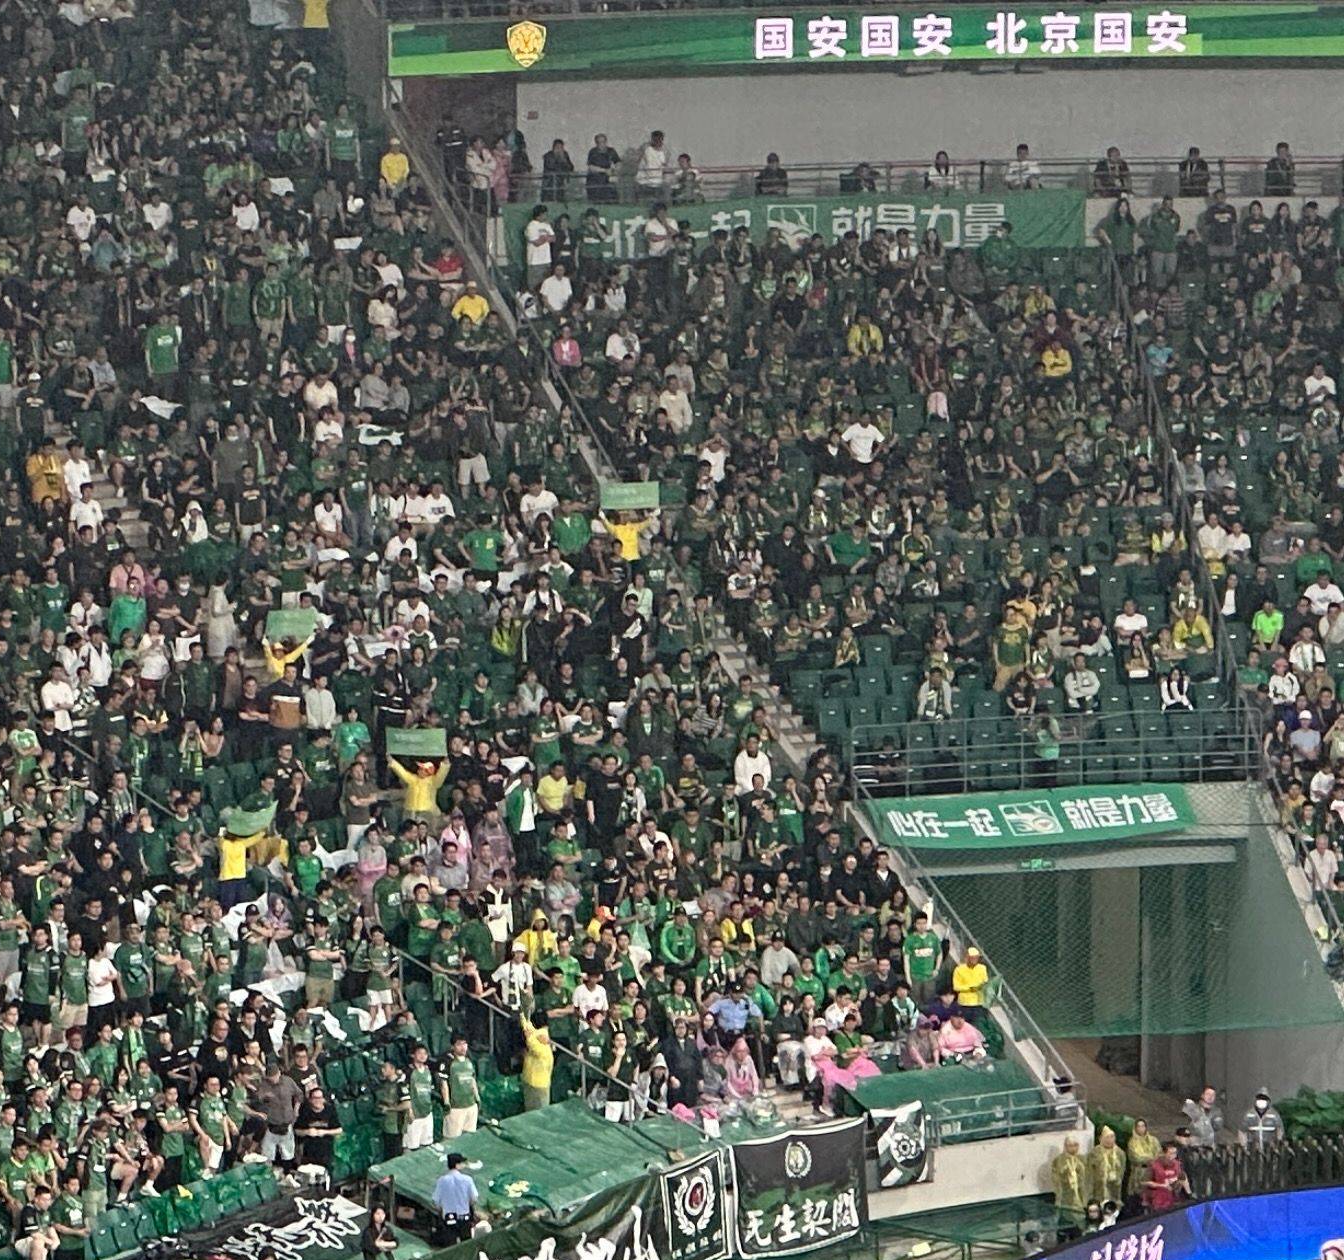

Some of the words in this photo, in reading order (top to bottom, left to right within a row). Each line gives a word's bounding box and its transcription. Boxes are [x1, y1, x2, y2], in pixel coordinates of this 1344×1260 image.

[755, 14, 952, 58] 国安国安
[986, 11, 1187, 54] 北京国安
[886, 807, 1002, 838] 心在一起
[1060, 793, 1178, 831] 就是力量
